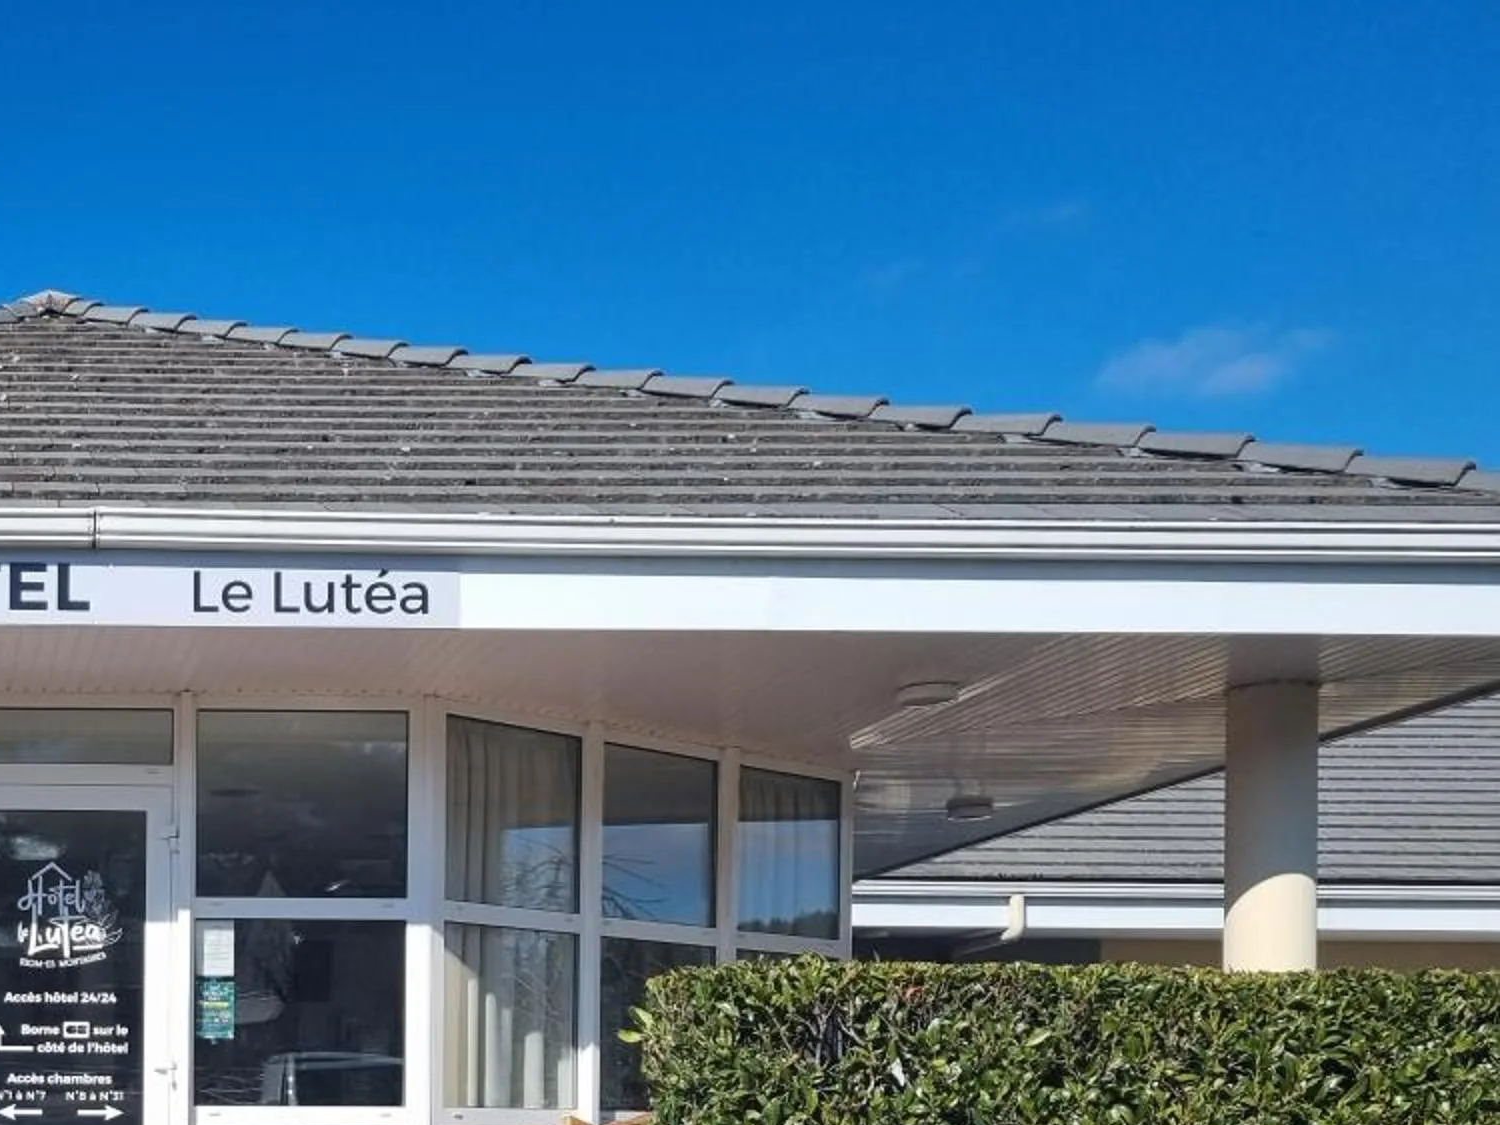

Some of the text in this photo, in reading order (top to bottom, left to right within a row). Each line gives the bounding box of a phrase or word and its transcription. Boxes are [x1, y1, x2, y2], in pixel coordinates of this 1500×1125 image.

[193, 568, 429, 614] Le Lutéa
[4, 992, 117, 1004] Accès hôtel 24/24
[21, 1024, 129, 1036] Borne sur le
[37, 1042, 66, 1053] côté
[68, 1042, 85, 1053] de
[7, 1072, 113, 1086] Accès chambres
